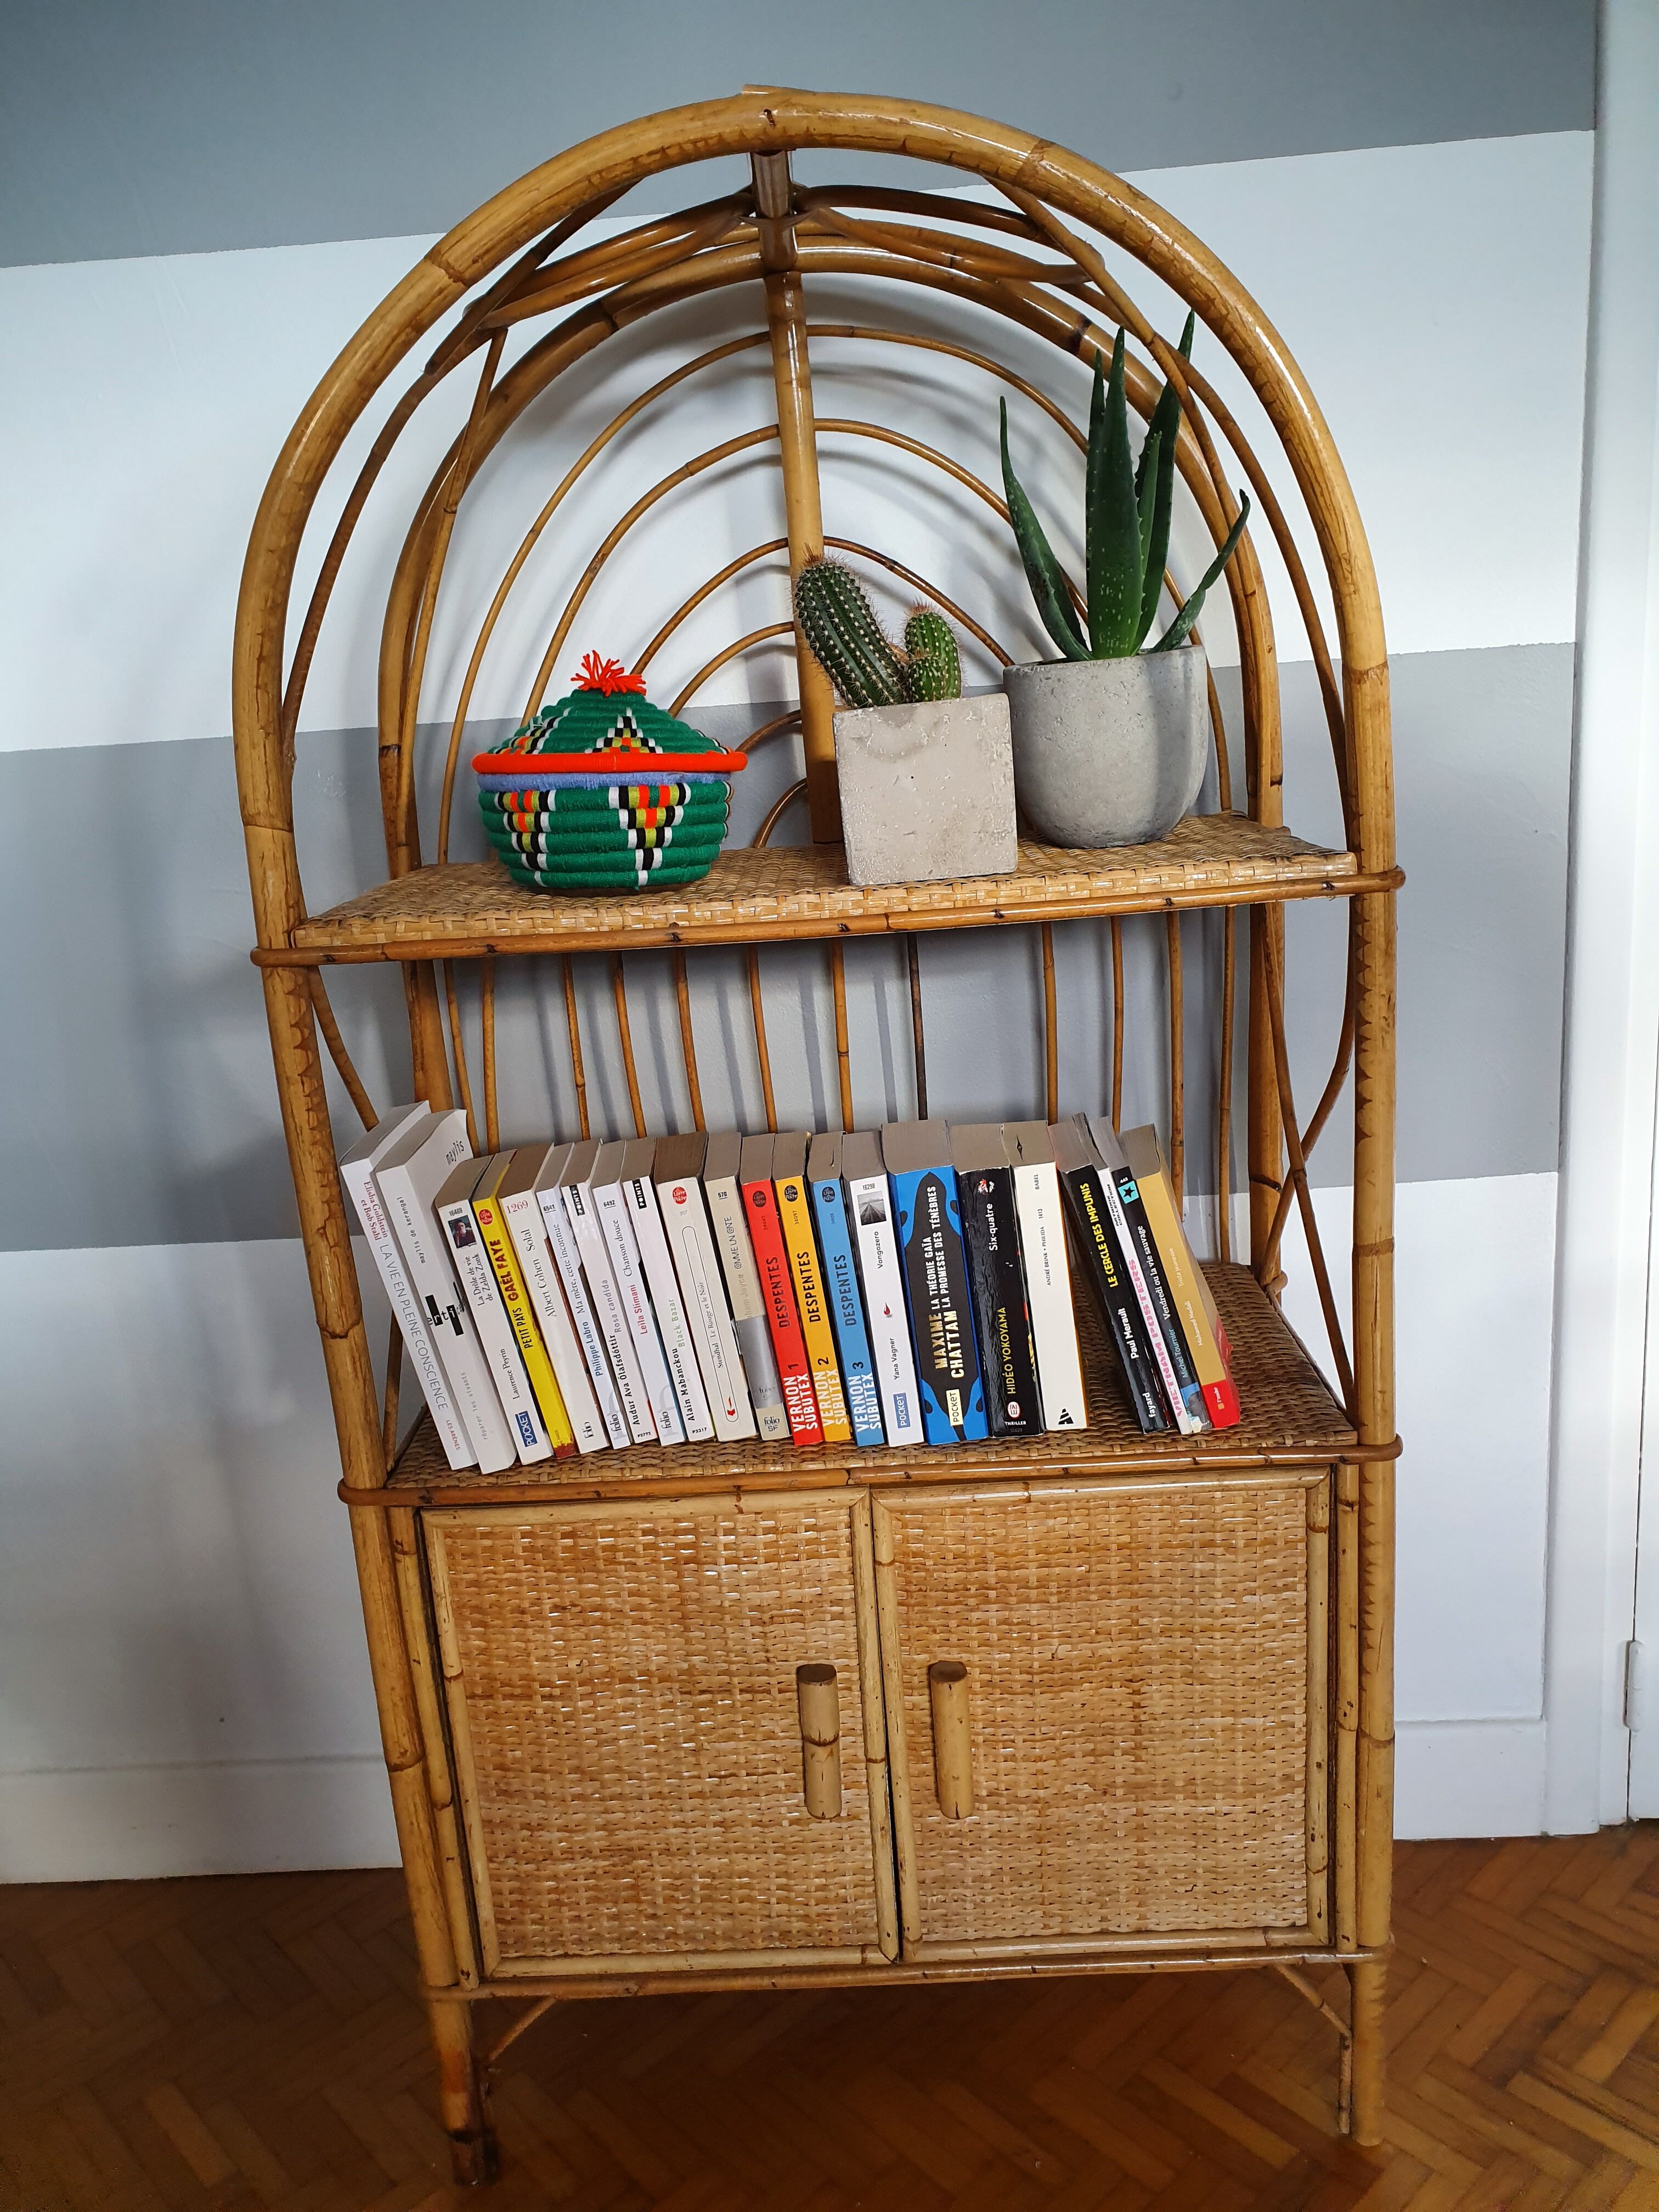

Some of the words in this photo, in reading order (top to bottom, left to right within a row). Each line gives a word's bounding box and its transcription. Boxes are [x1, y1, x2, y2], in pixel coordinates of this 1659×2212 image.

[445, 1141, 465, 1165] maylis
[506, 1200, 528, 1214] 1269
[635, 1183, 645, 1206] POINTS
[1080, 1183, 1099, 1223] IMPUNIS
[1107, 1184, 1122, 1226] COLLECTION
[363, 1181, 376, 1204] Elisha
[373, 1204, 388, 1238] Goldstein
[364, 1206, 375, 1221] Bob
[397, 1197, 413, 1226] kerangal
[927, 1186, 941, 1229] TÉNÈBRES
[1107, 1195, 1119, 1226] ARTBOOK
[369, 1221, 382, 1240] Stahl
[410, 1229, 416, 1238] de
[521, 1228, 535, 1251] Solal
[613, 1220, 624, 1242] douce
[985, 1203, 998, 1251] Six-quatre
[1092, 1223, 1105, 1243] DES
[380, 1244, 392, 1260] LA
[414, 1240, 426, 1264] maylis
[553, 1223, 568, 1260] inconnue
[874, 1231, 883, 1269] Vongozero
[921, 1236, 933, 1258] GAÏA
[933, 1232, 943, 1248] DES
[1137, 1225, 1151, 1255] sauvage
[489, 1239, 509, 1270] FAYE
[619, 1243, 633, 1277] Chanson
[1098, 1243, 1114, 1275] CERCLE
[1146, 1255, 1155, 1267] vie
[1169, 1248, 1181, 1272] jeunesse
[387, 1261, 401, 1280] VIE
[467, 1267, 475, 1276] de
[479, 1271, 490, 1291] Zelda
[533, 1258, 547, 1289] Cohen
[565, 1260, 574, 1277] cette
[926, 1261, 938, 1296] THÉORIE
[935, 1250, 949, 1294] PROMESSE
[1150, 1267, 1158, 1277] la
[1154, 1276, 1161, 1285] ou
[1176, 1272, 1185, 1287] Triste
[394, 1282, 407, 1297] EN
[470, 1277, 481, 1296] Drôle
[500, 1271, 520, 1301] GAËL
[738, 1273, 748, 1296] Joyce
[766, 1257, 789, 1328] DESPENTES
[797, 1251, 821, 1323] DESPENTES
[833, 1255, 857, 1326] DESPENTES
[1108, 1275, 1119, 1288] LE
[486, 1293, 493, 1302] de
[542, 1291, 557, 1317] Albert
[575, 1301, 585, 1314] Ma
[601, 1279, 616, 1311] candida
[628, 1284, 642, 1314] Slimani
[930, 1298, 940, 1310] LA
[941, 1296, 951, 1308] LA
[1128, 1259, 1159, 1339] POSTERS
[1155, 1285, 1171, 1320] Vendredi
[400, 1299, 422, 1338] PLEINE
[512, 1307, 526, 1327] PAYS
[668, 1299, 679, 1322] Bazar
[706, 1309, 714, 1329] Rouge
[582, 1321, 594, 1344] Labro
[613, 1313, 622, 1334] Rosa
[636, 1314, 648, 1335] Leïla
[674, 1324, 685, 1348] Black
[997, 1307, 1012, 1362] YOKOYAMA
[1118, 1307, 1133, 1340] Merault
[1190, 1319, 1203, 1346] Mohamed
[519, 1328, 533, 1350] PETIT
[889, 1338, 898, 1362] Vagner
[929, 1312, 948, 1369] MAXIME
[943, 1310, 964, 1378] CHATTAM
[1126, 1340, 1139, 1359] Paul
[1169, 1329, 1182, 1357] Tournier
[499, 1348, 511, 1370] Peyrin
[589, 1345, 603, 1376] Philippe
[609, 1334, 627, 1380] Ólafsdóttir
[712, 1342, 723, 1369] Stendhal
[817, 1357, 829, 1366] 2
[852, 1361, 864, 1370] 3
[1178, 1357, 1189, 1378] Michel
[415, 1340, 448, 1410] CONSCIENCE
[461, 1372, 473, 1397] vivants
[507, 1369, 520, 1400] Laurence
[672, 1348, 689, 1396] Mabanckou
[1002, 1364, 1016, 1394] HIDÉO
[1155, 1342, 1182, 1417] VIETNAM
[623, 1383, 633, 1397] Ava
[796, 1373, 818, 1430] SUBUTEX
[814, 1371, 835, 1427] VERNON
[826, 1368, 847, 1425] SUBUTEX
[861, 1373, 882, 1430] SUBUTEX
[628, 1400, 640, 1425] Audur
[684, 1398, 695, 1422] Alain
[783, 1376, 806, 1432] VERNON
[848, 1375, 870, 1432] VERNON
[1142, 1392, 1156, 1418] fayard
[476, 1415, 488, 1440] réparer
[518, 1413, 535, 1446] POCKET
[610, 1414, 622, 1432] folio
[660, 1411, 672, 1429] folio
[764, 1417, 780, 1425] folio
